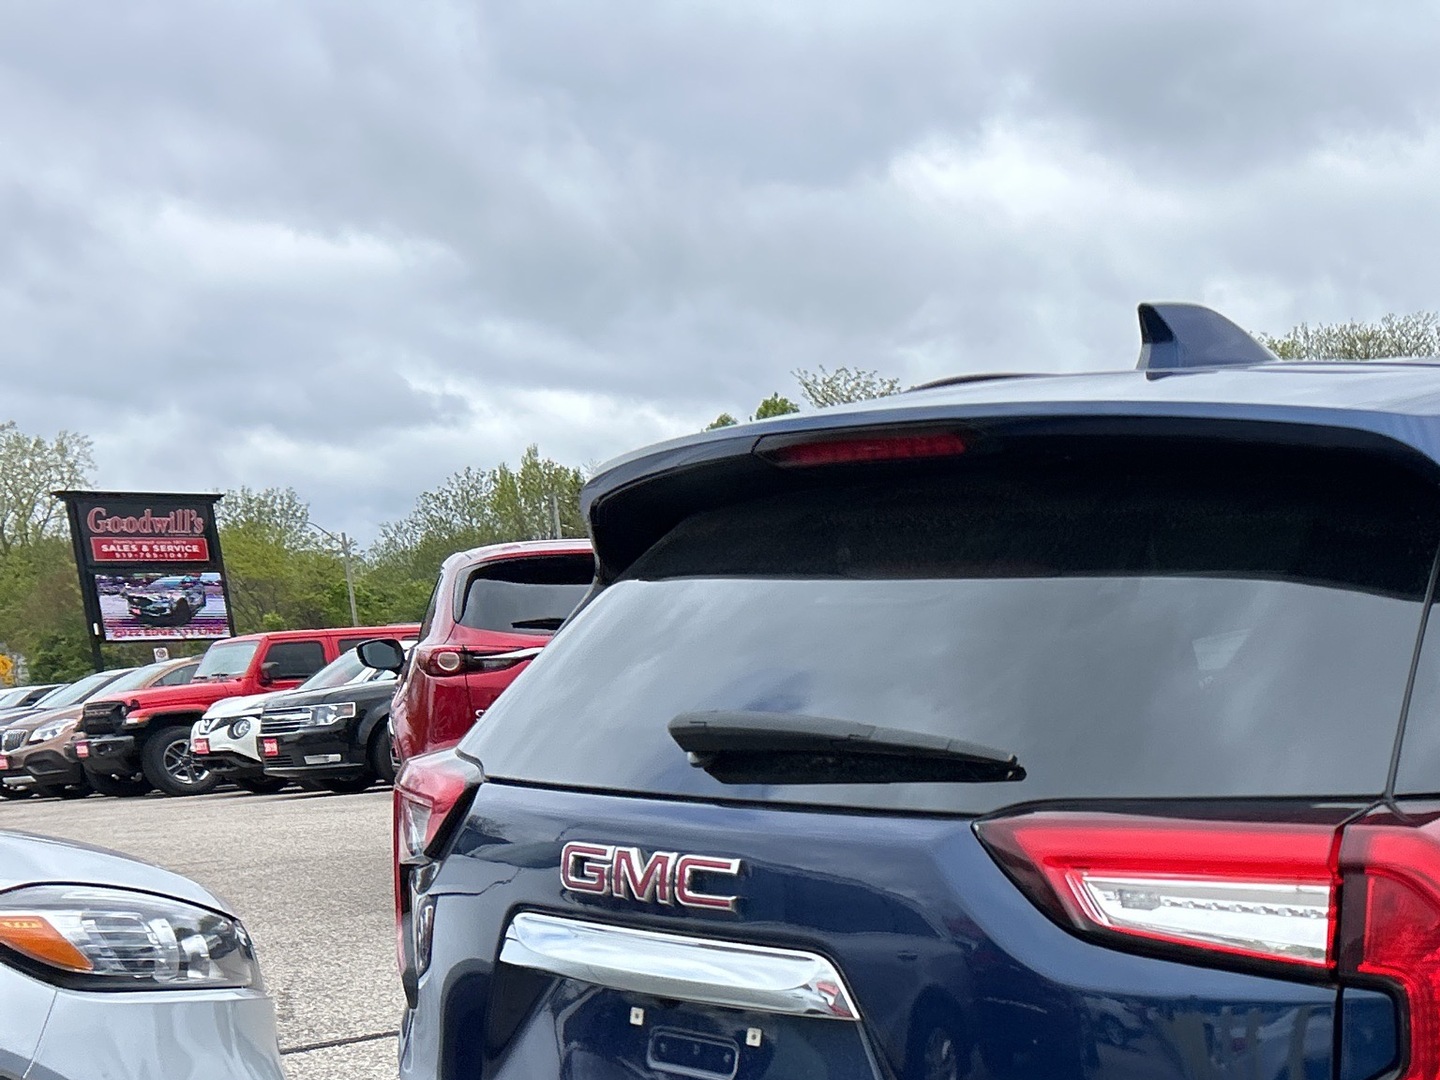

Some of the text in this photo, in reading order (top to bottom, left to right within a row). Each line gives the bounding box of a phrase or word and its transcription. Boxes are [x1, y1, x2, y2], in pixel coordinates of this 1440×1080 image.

[87, 507, 204, 534] Goodwill's
[101, 544, 138, 552] SALES
[152, 545, 200, 553] SERVICE
[561, 841, 741, 912] GMC
